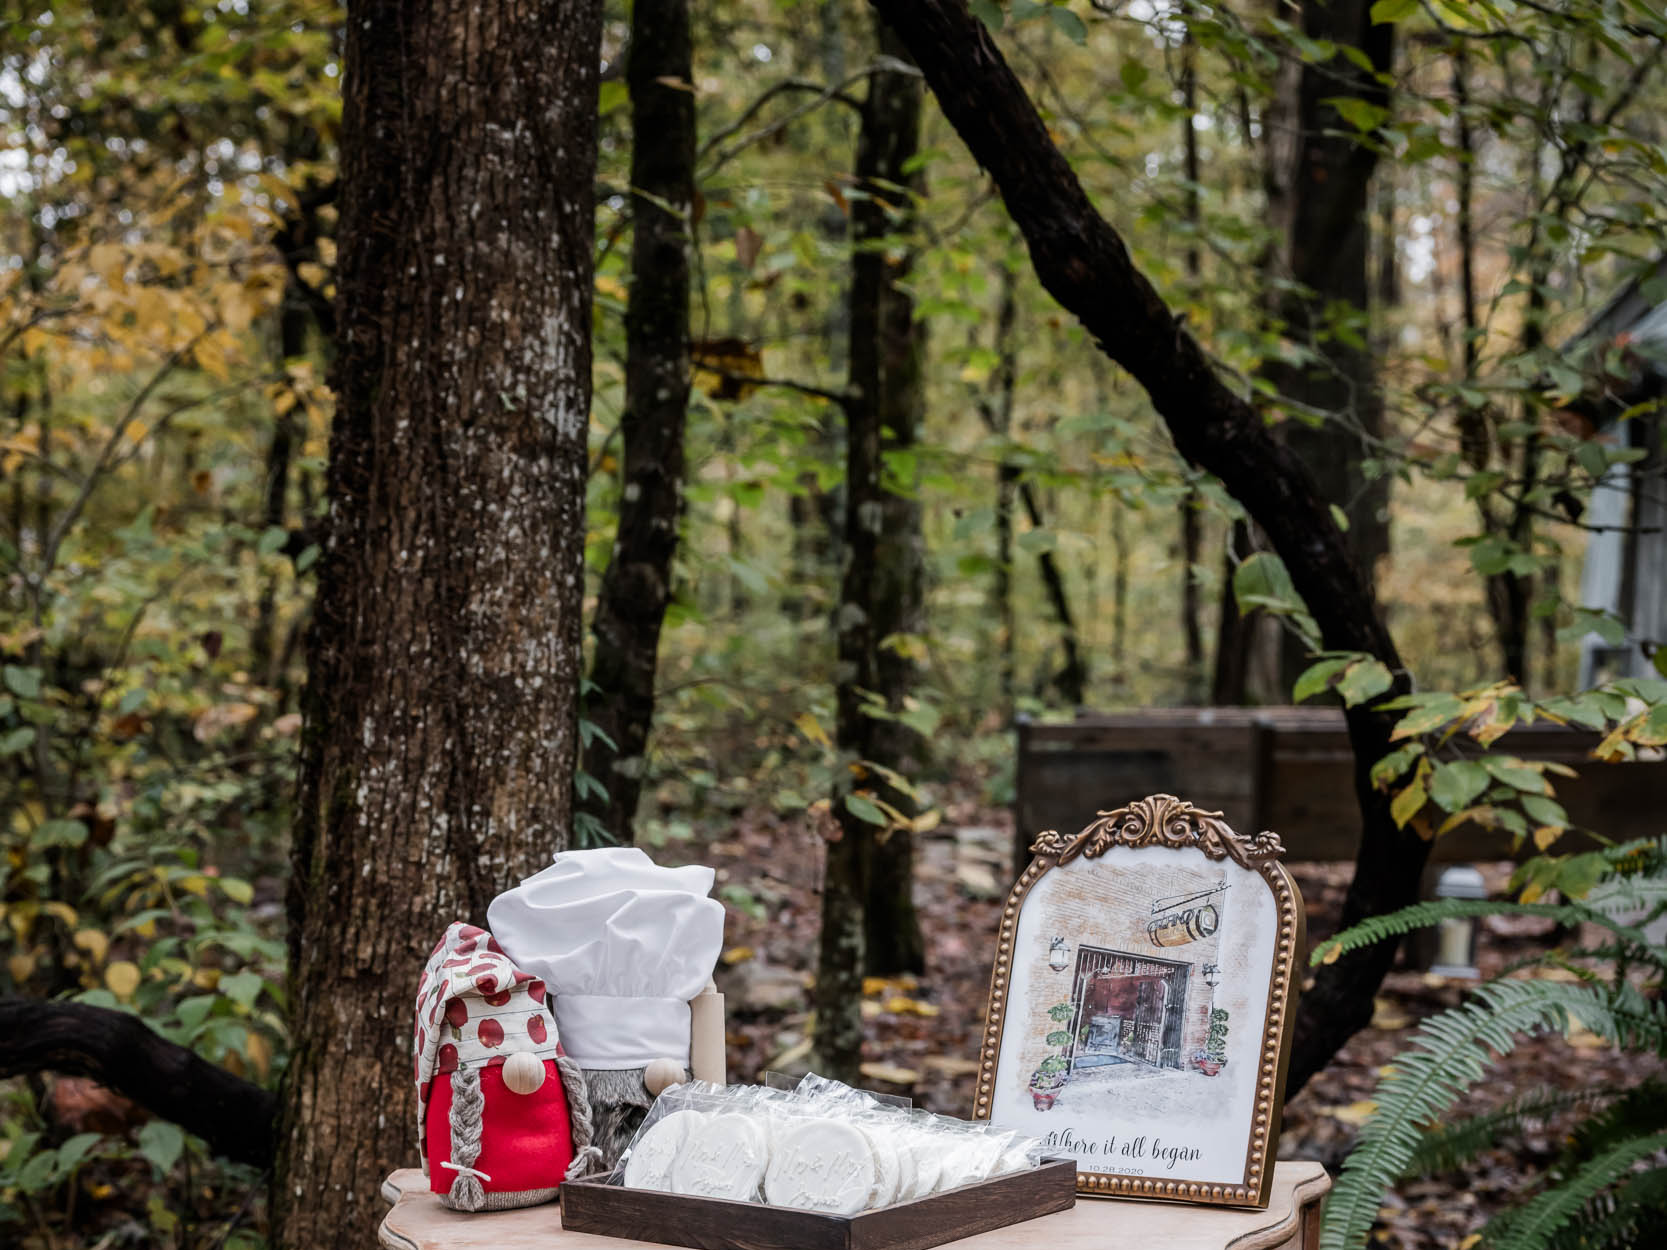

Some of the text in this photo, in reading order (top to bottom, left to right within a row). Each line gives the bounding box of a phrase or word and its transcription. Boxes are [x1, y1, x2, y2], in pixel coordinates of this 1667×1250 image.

[1041, 1127, 1203, 1170] Where it all began
[1088, 1164, 1144, 1176] 10.28.2020
